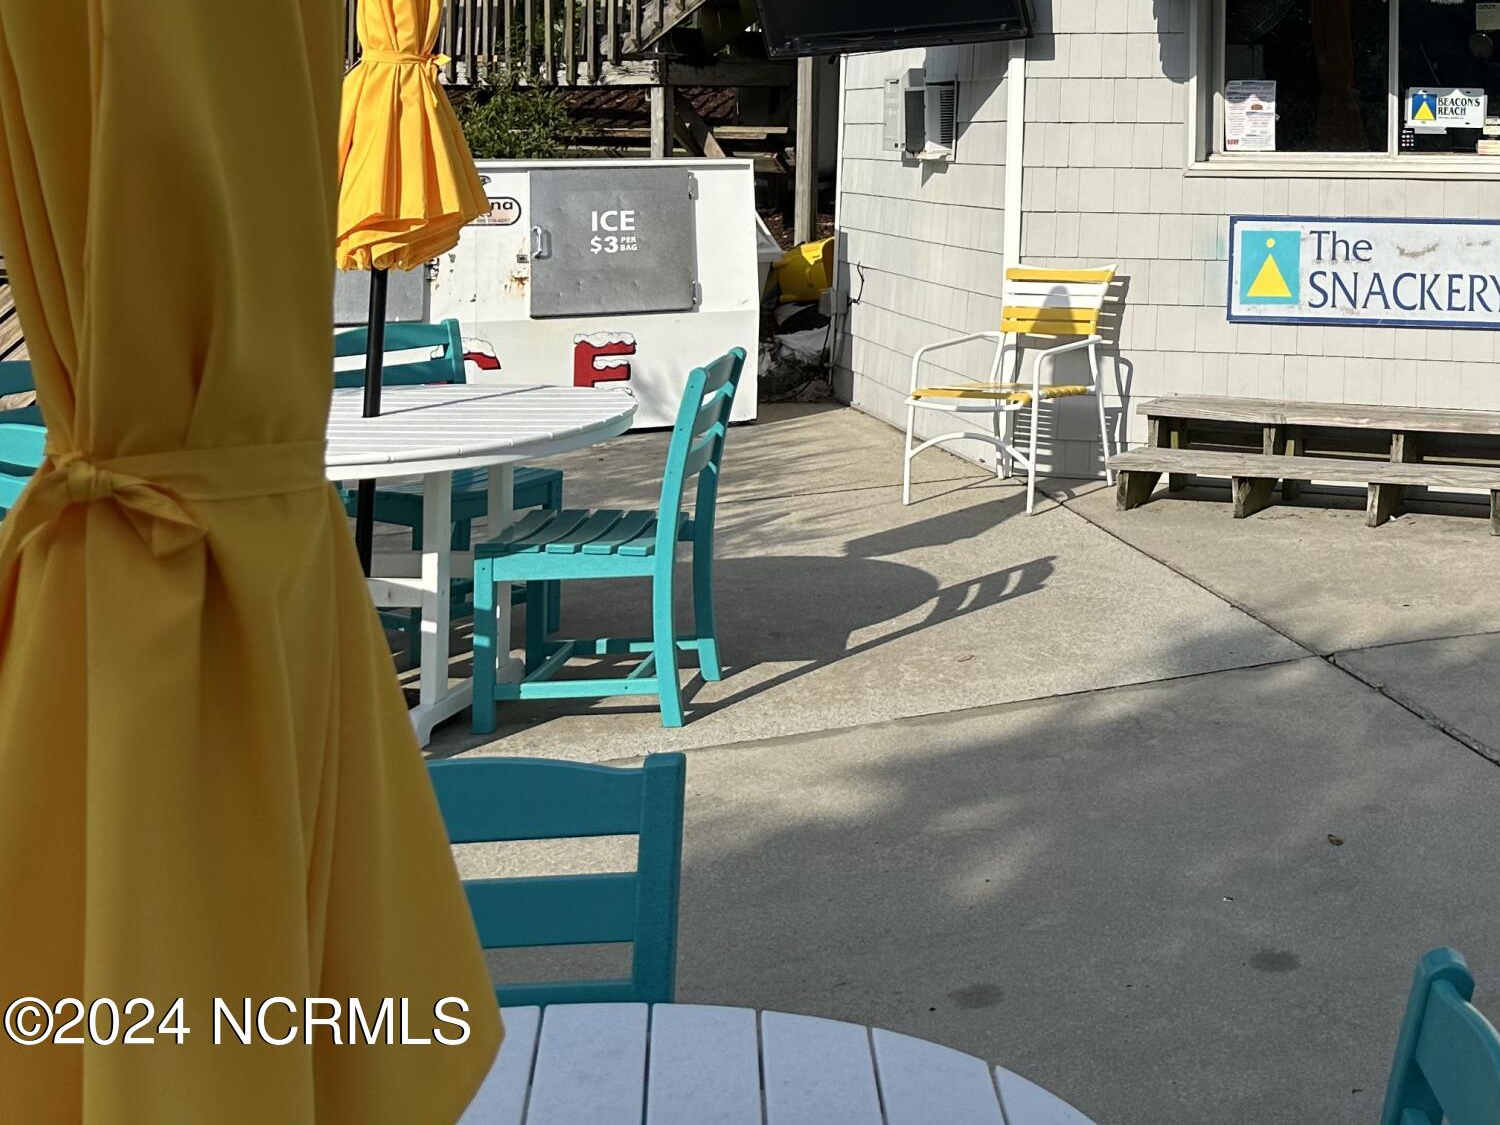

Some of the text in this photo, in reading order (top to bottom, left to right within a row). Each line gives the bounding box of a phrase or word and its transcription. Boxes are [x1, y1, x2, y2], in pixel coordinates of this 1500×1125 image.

[1438, 107, 1466, 116] REACH
[591, 210, 636, 232] ICE
[590, 235, 619, 255] $3
[620, 236, 637, 244] PER
[1309, 230, 1373, 262] The
[620, 244, 638, 252] BAG
